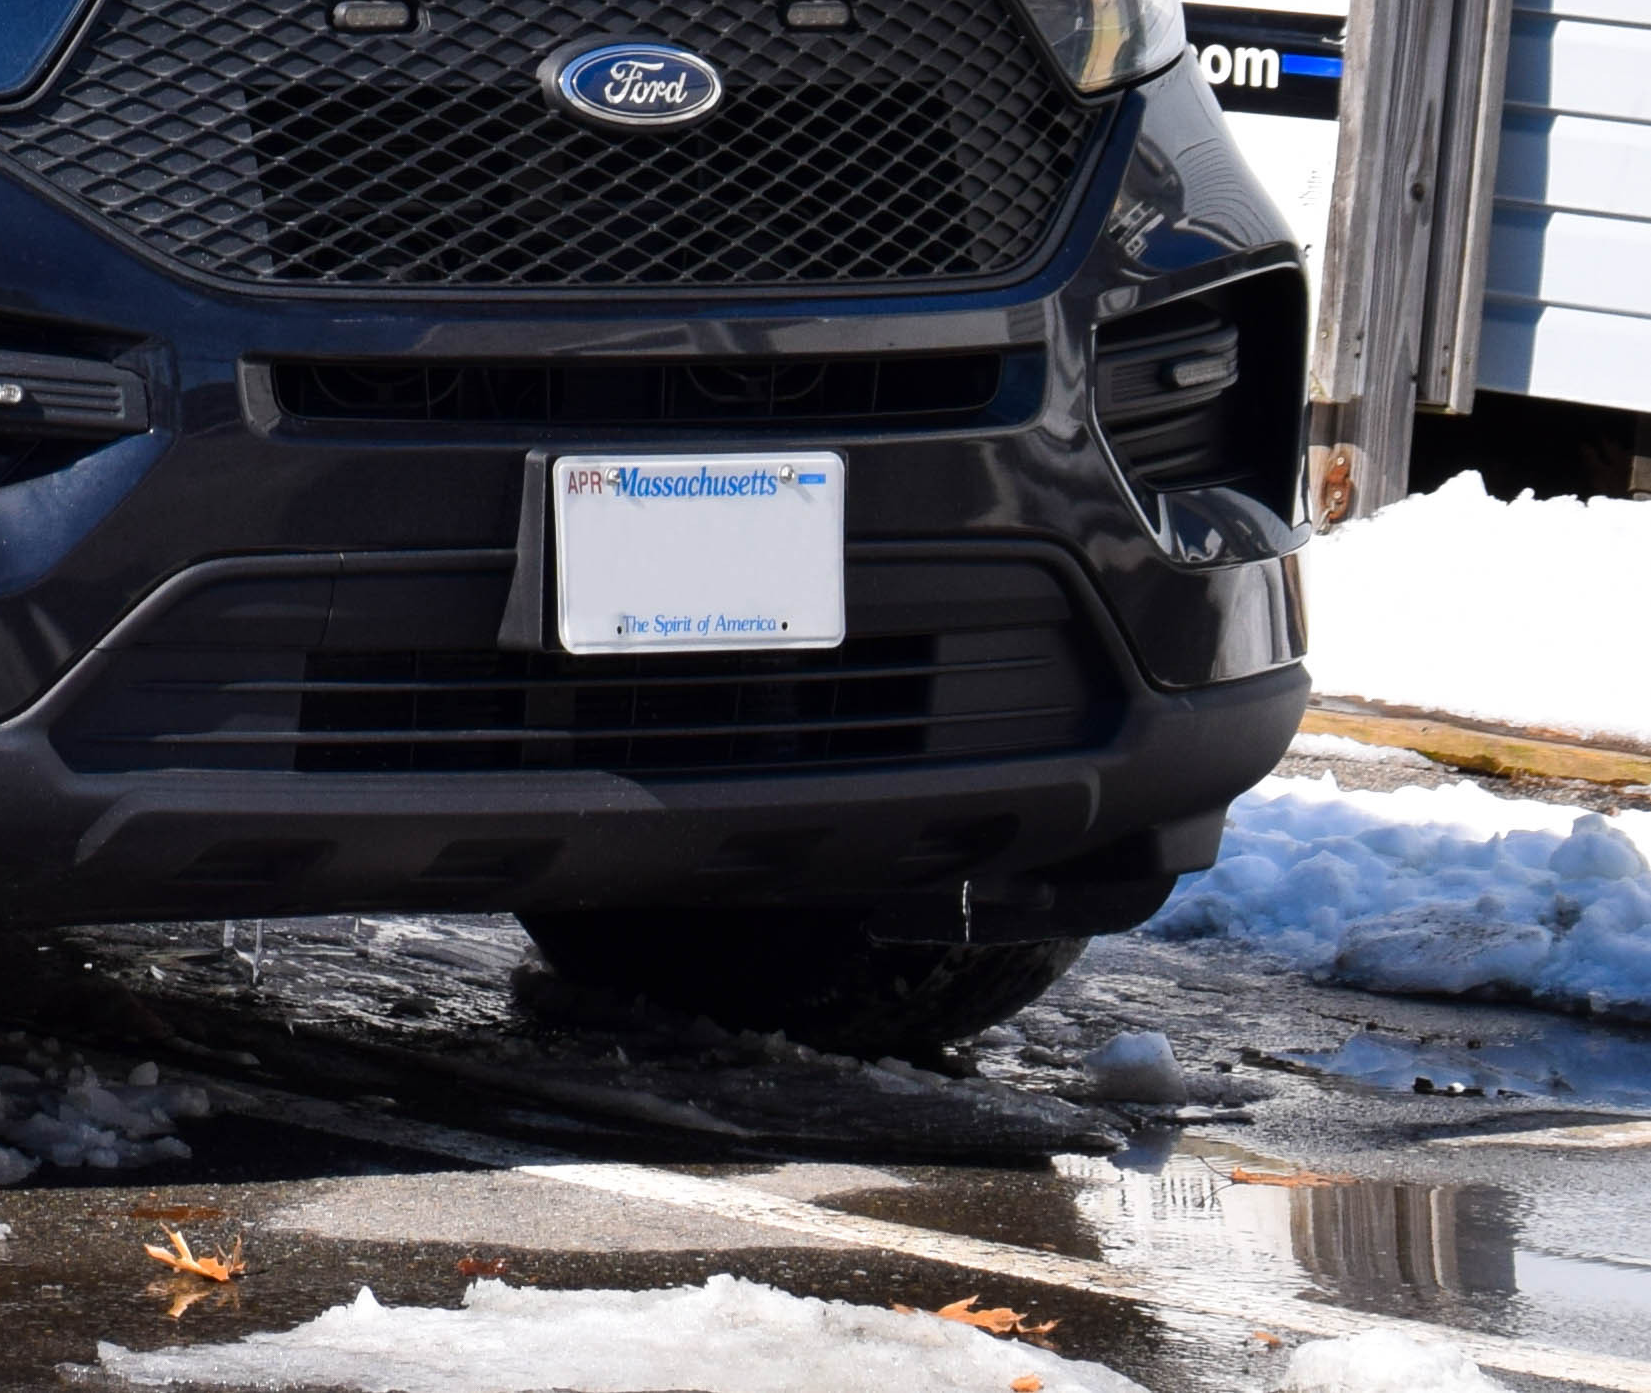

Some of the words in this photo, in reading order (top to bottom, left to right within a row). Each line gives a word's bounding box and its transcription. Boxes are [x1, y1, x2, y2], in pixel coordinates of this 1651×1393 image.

[604, 60, 689, 105] Ford
[566, 469, 603, 496] APR
[615, 465, 778, 499] Massachusetts
[622, 614, 650, 634] The
[653, 614, 692, 638] Spirit
[696, 614, 712, 637] of
[714, 613, 777, 633] America
